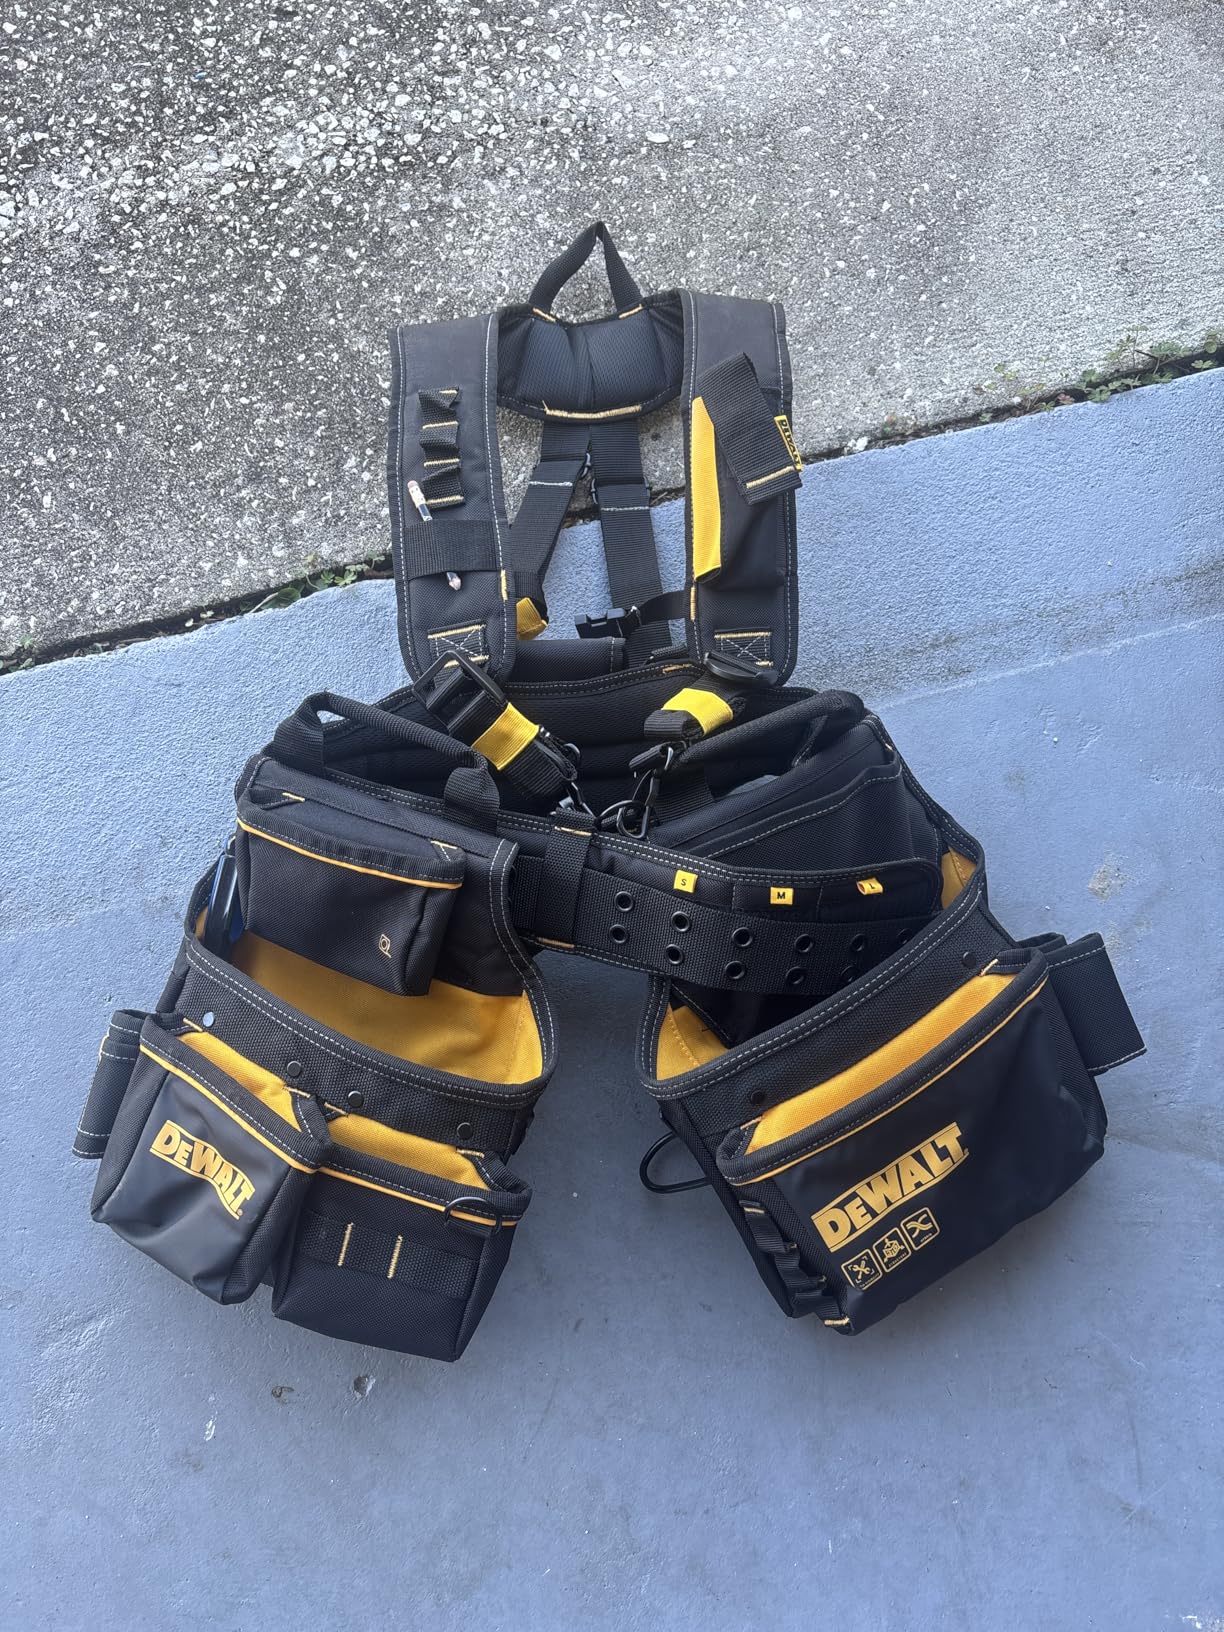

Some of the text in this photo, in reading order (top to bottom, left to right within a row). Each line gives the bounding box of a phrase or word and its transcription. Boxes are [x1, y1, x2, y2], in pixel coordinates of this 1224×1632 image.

[680, 878, 688, 887] S
[776, 891, 786, 900] M
[149, 1119, 256, 1221] DEWALT
[810, 1121, 969, 1253] DEWALT
